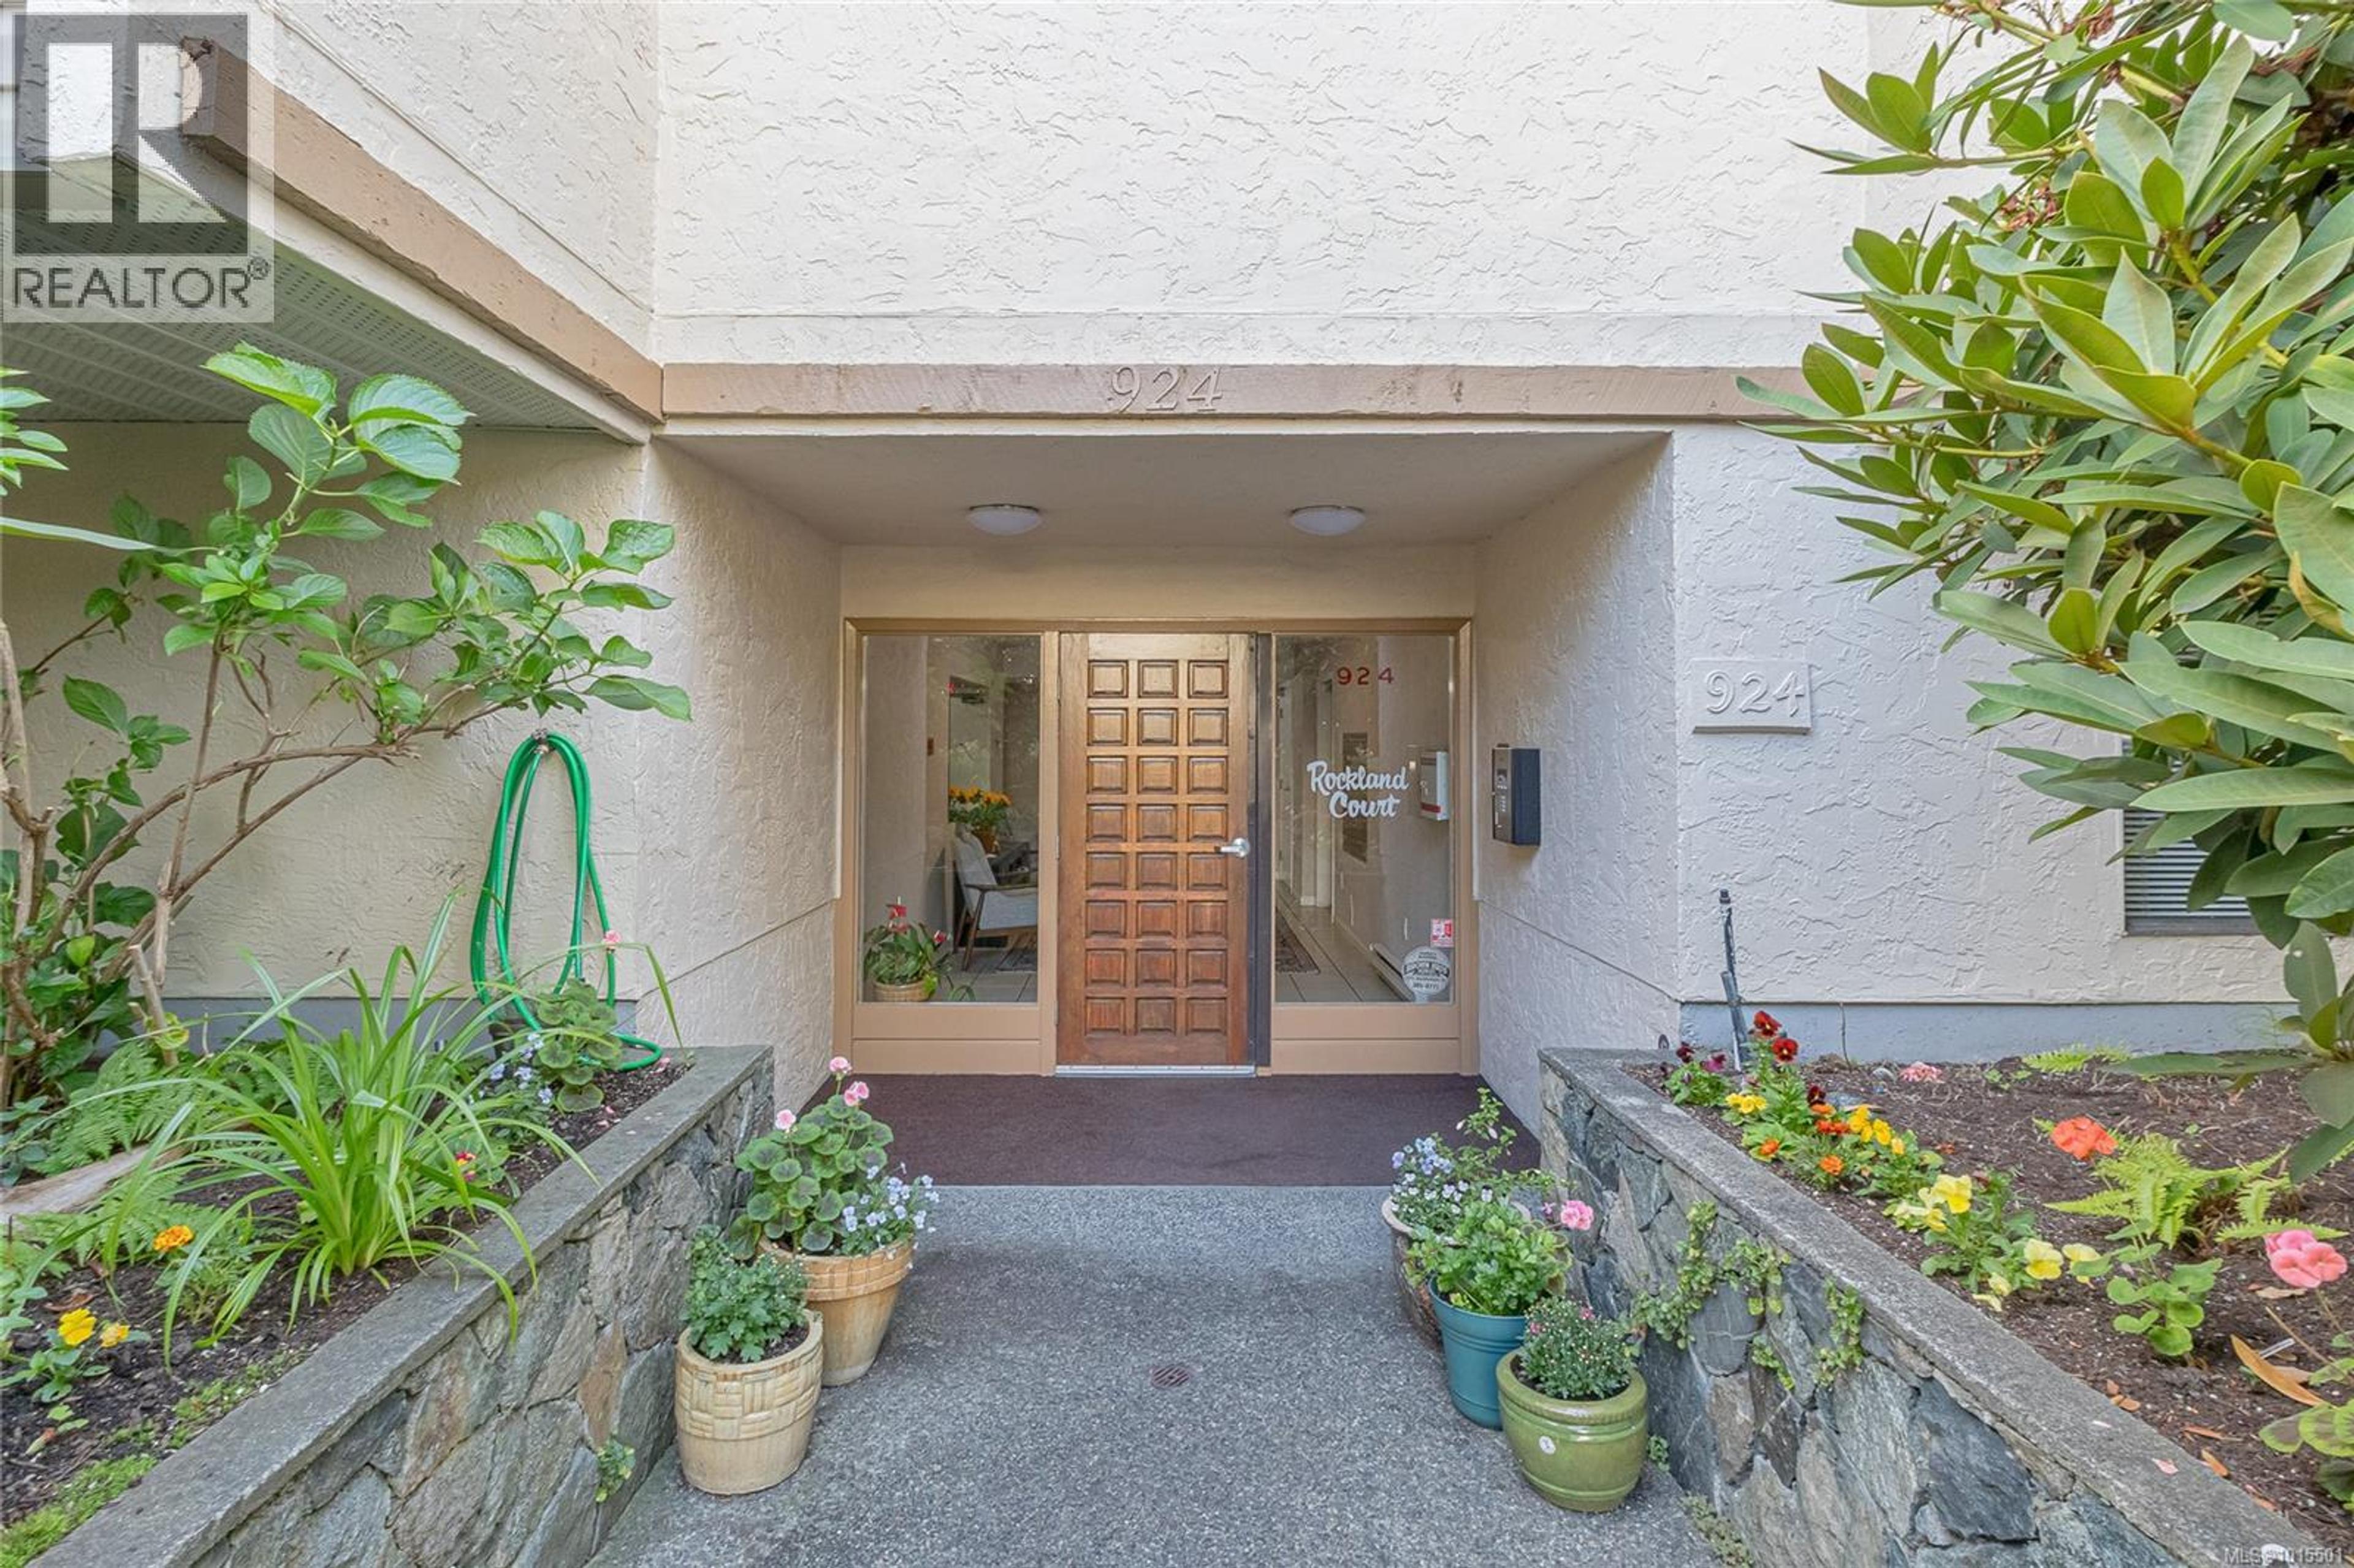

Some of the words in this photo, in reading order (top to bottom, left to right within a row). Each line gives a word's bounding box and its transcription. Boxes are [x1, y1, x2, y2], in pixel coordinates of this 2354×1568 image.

[1110, 367, 1223, 413] 924
[1337, 666, 1394, 685] 924
[1706, 671, 1805, 717] 924
[1306, 760, 1409, 796] Rockland
[1329, 790, 1401, 818] Court
